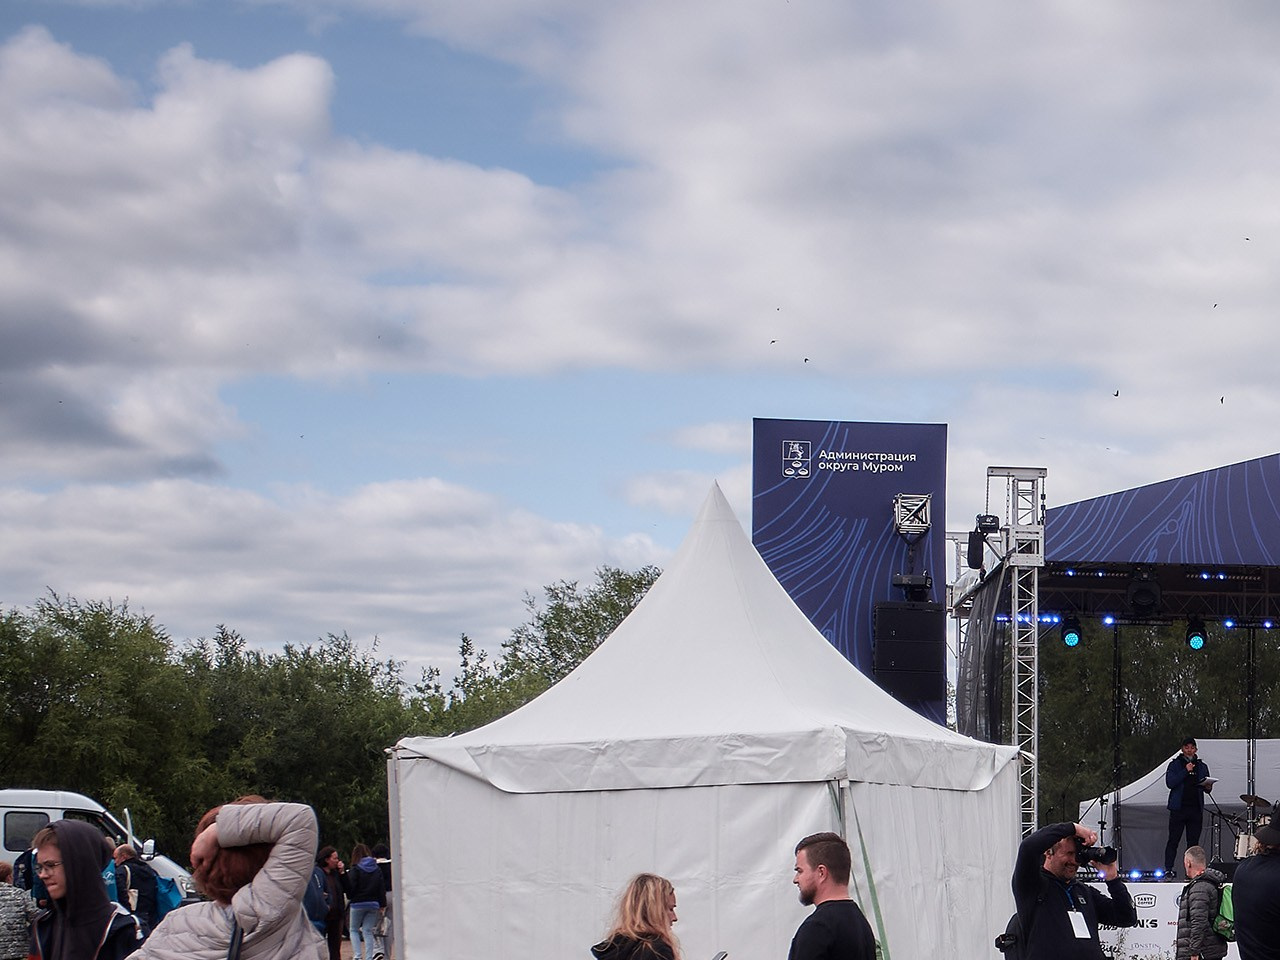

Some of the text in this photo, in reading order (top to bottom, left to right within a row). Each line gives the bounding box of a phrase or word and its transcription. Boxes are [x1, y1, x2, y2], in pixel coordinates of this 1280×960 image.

[819, 450, 916, 461] Администрация
[818, 461, 904, 472] округа Муром
